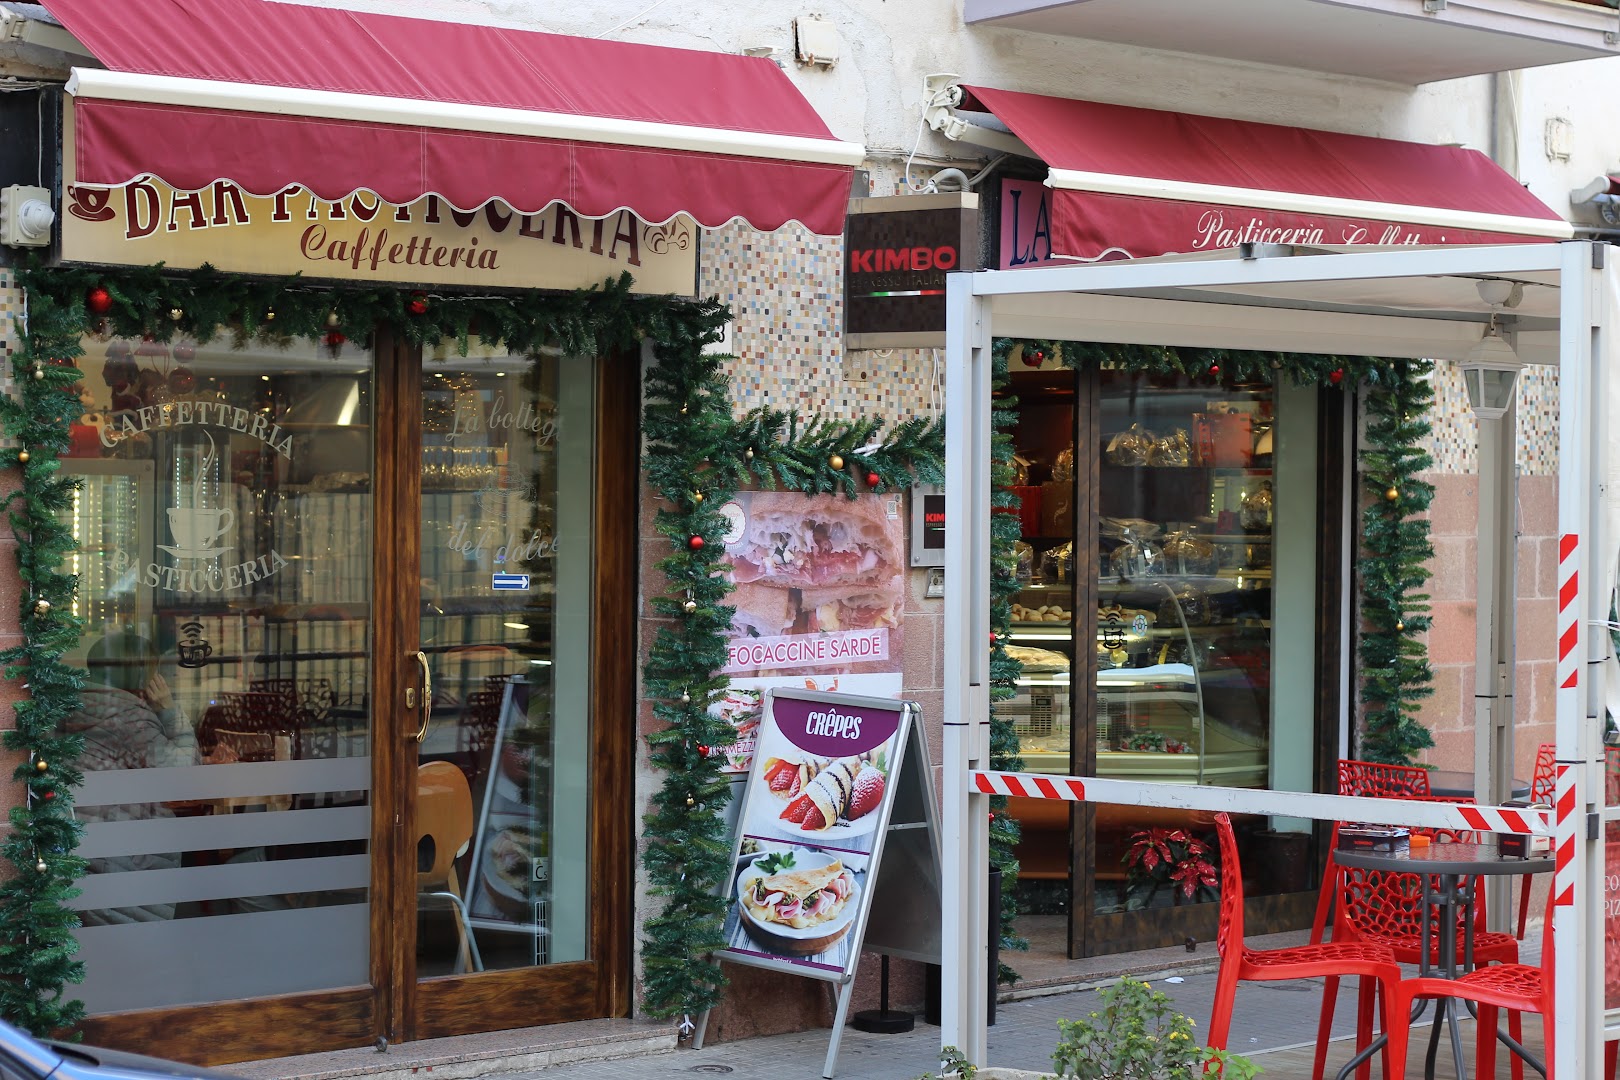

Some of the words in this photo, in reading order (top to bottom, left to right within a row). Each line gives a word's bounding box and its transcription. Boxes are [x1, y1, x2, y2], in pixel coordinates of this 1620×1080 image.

[300, 223, 500, 271] Caffetteria
[1009, 190, 1052, 266] LA
[1192, 209, 1324, 248] Pasticceria
[851, 246, 957, 273] KIMBO
[100, 401, 294, 460] CAFFETTERIA
[445, 402, 481, 442] La
[486, 396, 561, 447] botteg
[447, 522, 491, 560] del
[107, 549, 289, 593] PASTICCERIA
[728, 641, 825, 666] FOCACCINE
[830, 636, 881, 658] SARDE
